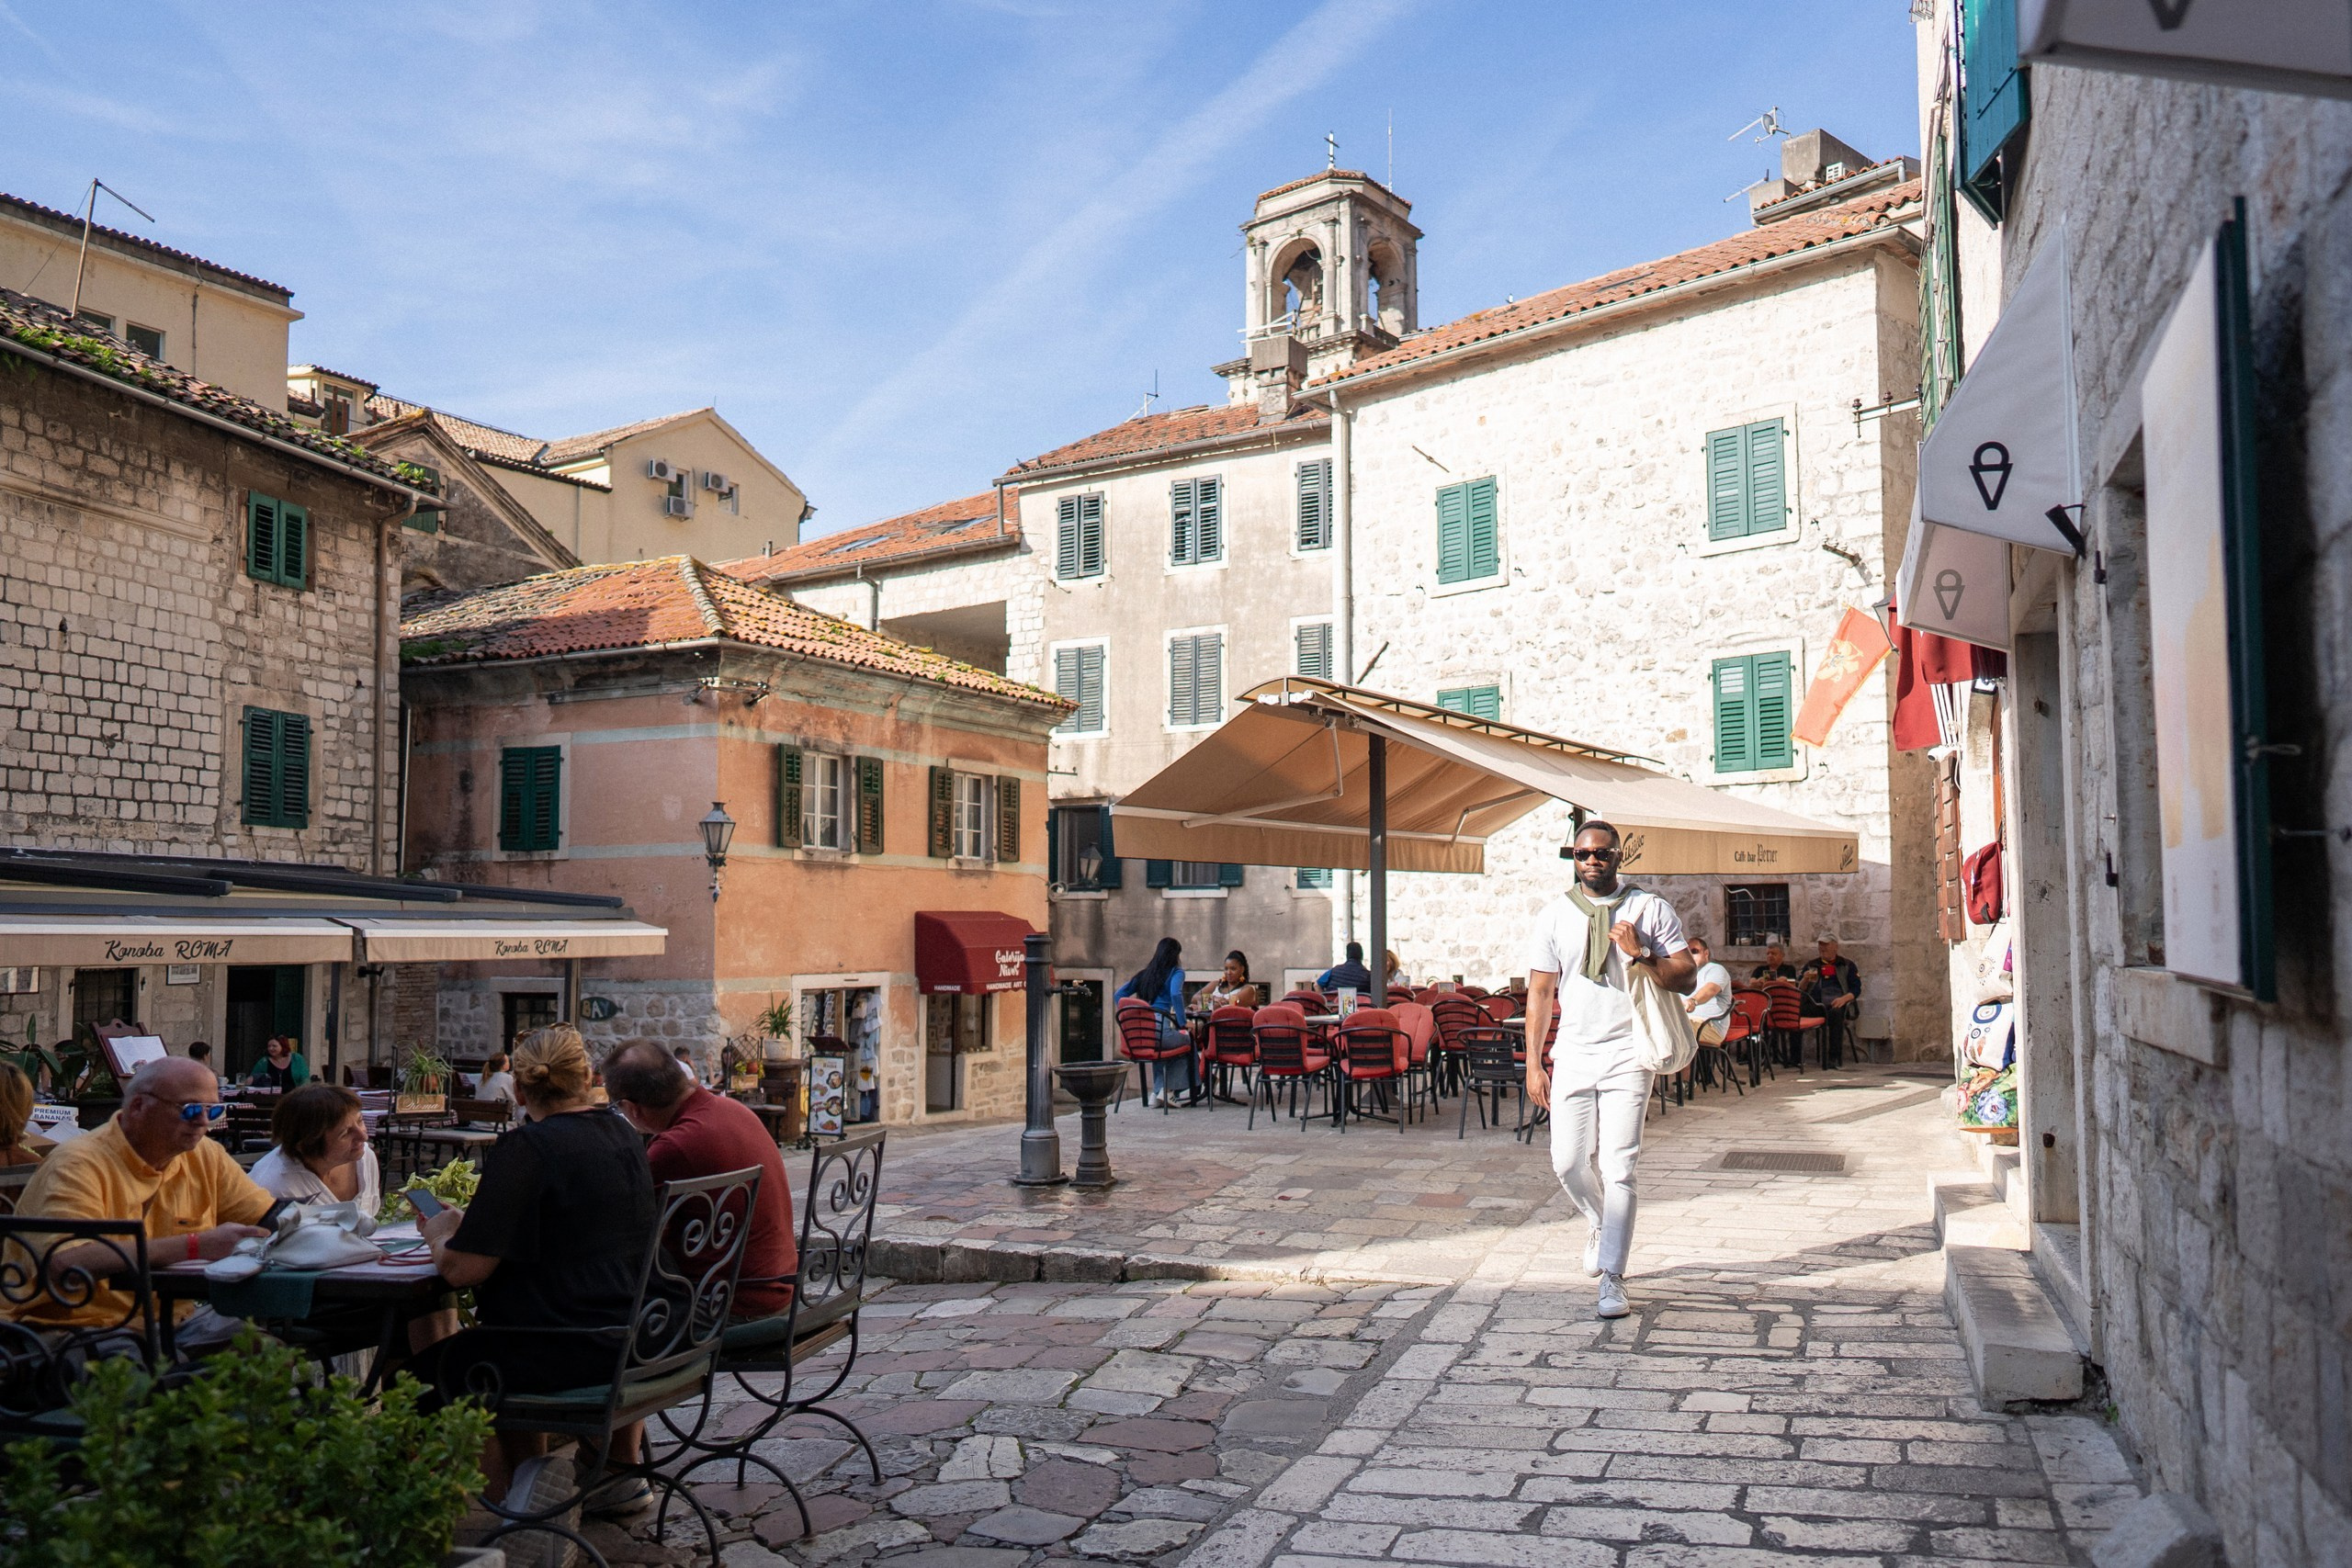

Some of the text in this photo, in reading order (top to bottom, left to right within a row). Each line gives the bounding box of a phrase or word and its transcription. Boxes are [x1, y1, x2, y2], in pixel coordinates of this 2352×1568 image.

[1747, 852, 1756, 862] bar
[105, 939, 233, 962] Konoba ROMA
[495, 939, 569, 956] Konoba ROMA
[995, 950, 1025, 968] Galerija
[986, 982, 1012, 990] HANDMADE
[34, 1107, 71, 1115] PREMIUM
